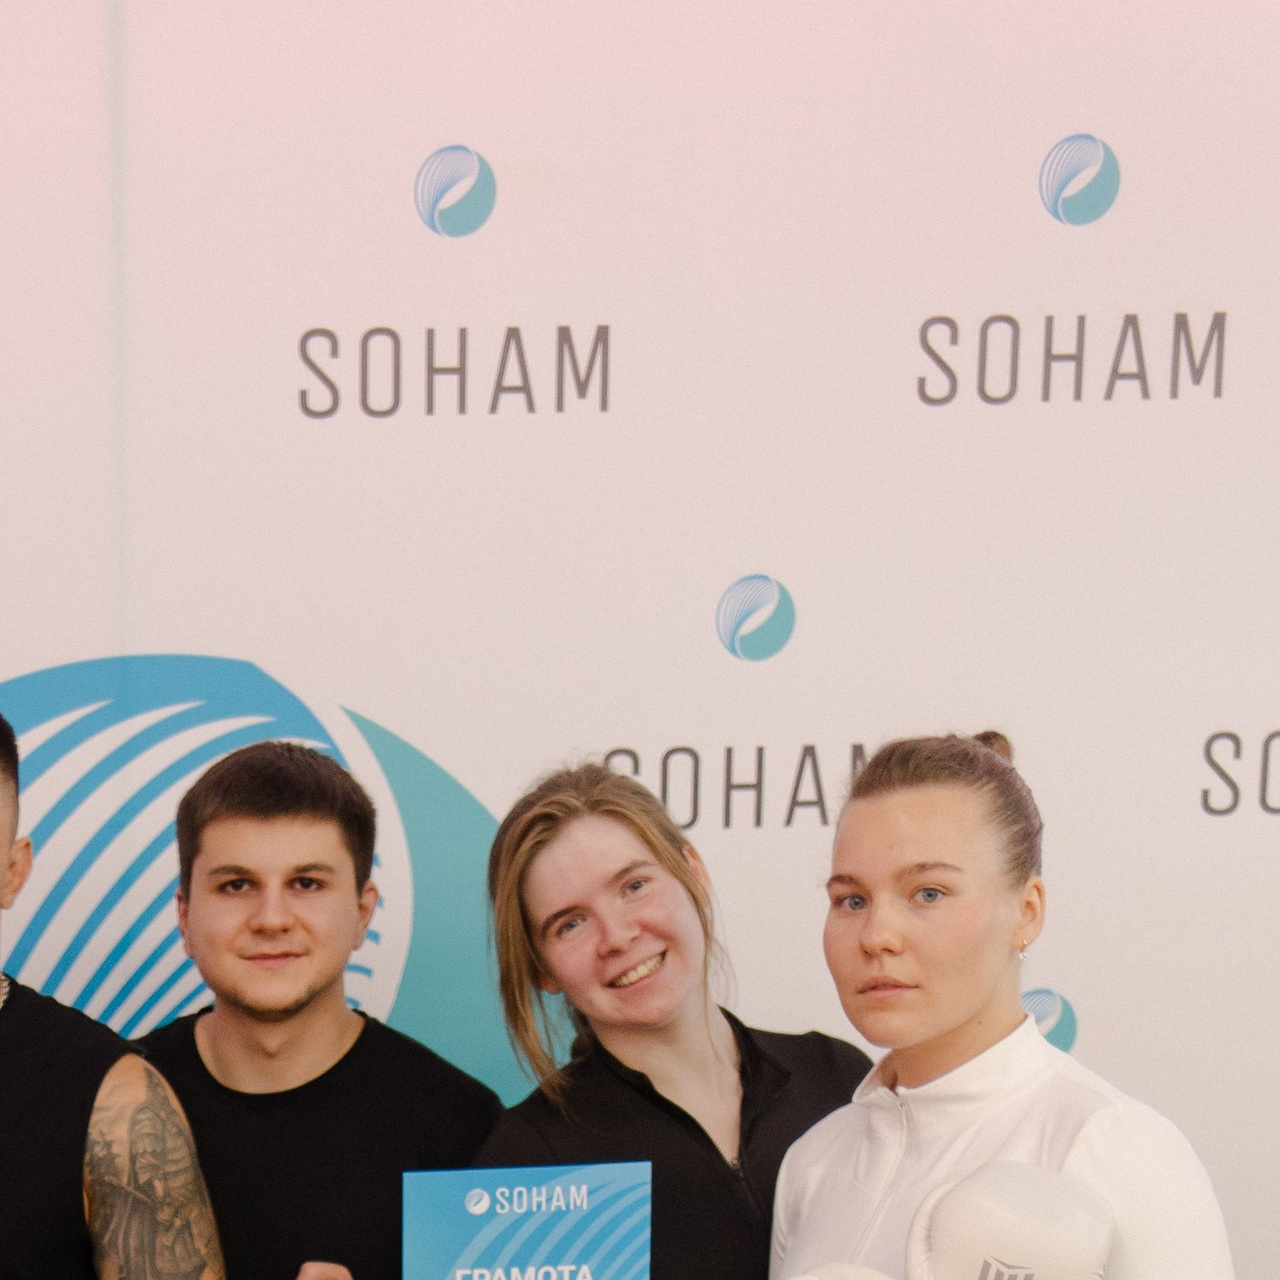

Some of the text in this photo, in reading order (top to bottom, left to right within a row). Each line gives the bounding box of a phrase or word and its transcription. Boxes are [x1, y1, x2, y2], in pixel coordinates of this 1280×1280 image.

[297, 323, 611, 418] SOHAM
[917, 310, 1227, 406] SOHAM
[604, 744, 880, 831] OHA
[495, 1185, 588, 1214] SOHAM
